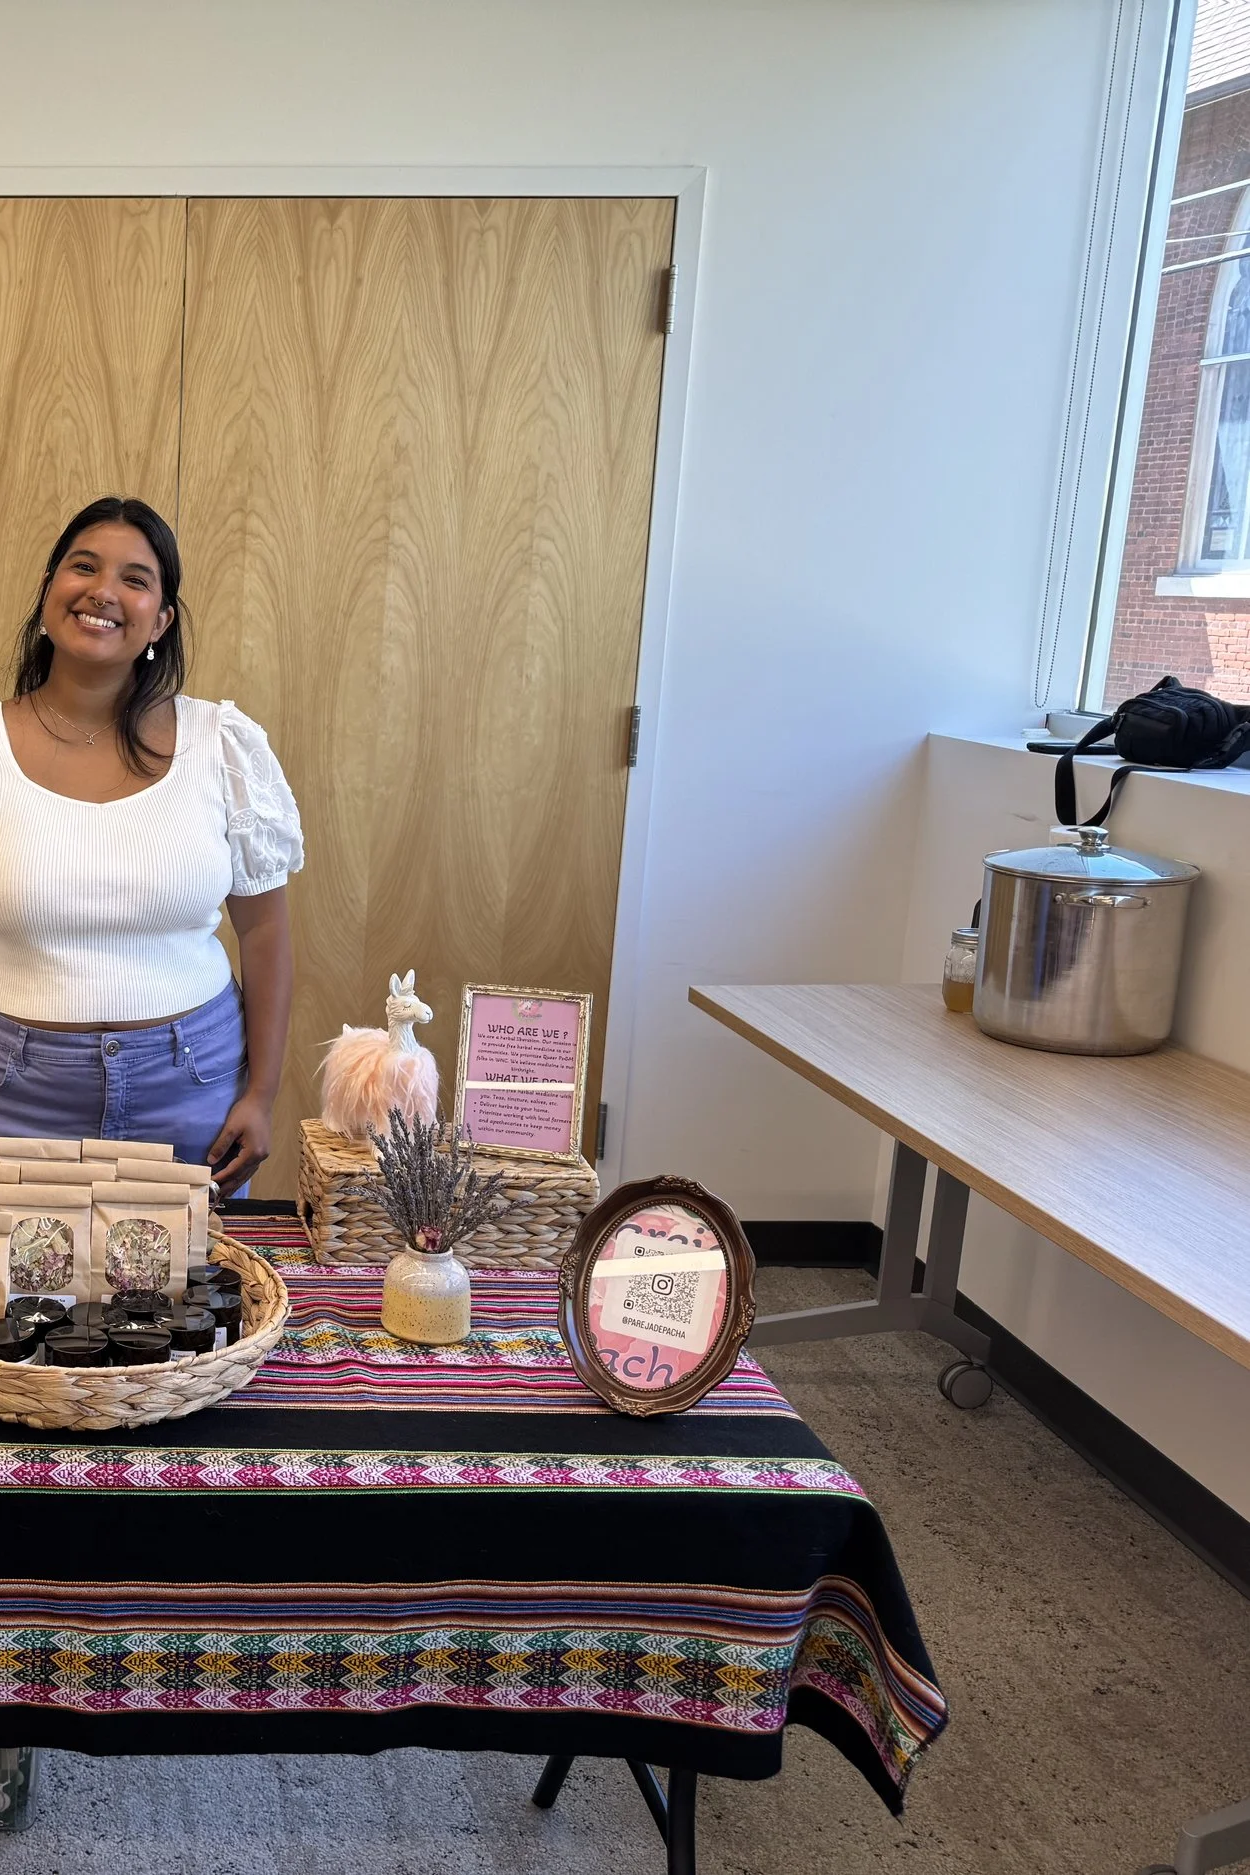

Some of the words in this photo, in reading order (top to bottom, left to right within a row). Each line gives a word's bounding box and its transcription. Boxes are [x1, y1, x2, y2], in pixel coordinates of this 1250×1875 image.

[488, 1024, 514, 1035] WHO
[517, 1026, 538, 1037] ARE
[542, 1029, 560, 1039] WE
[485, 1072, 518, 1082] WHAT
[622, 1316, 686, 1339] @PAREJADEPACHA
[591, 1340, 683, 1386] ach
